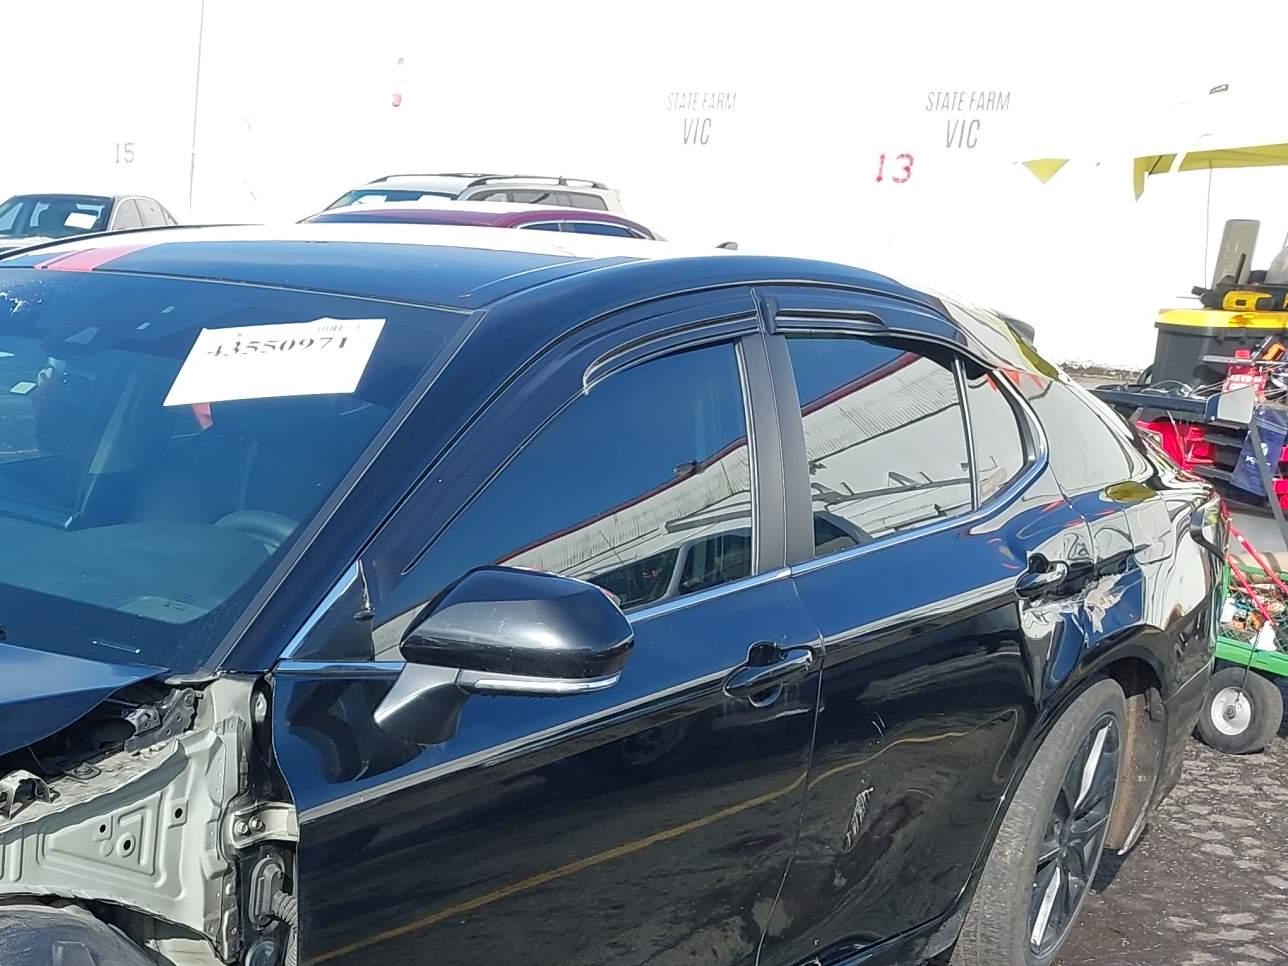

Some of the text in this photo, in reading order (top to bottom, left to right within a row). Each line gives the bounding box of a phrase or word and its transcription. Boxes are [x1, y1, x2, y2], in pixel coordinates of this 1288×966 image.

[667, 91, 736, 111] STATE FARM
[926, 91, 1011, 111] STATE FARM
[683, 117, 712, 145] VIC
[946, 119, 980, 148] VIC
[115, 142, 135, 164] 15
[876, 153, 914, 183] 13
[207, 336, 350, 357] 43550971
